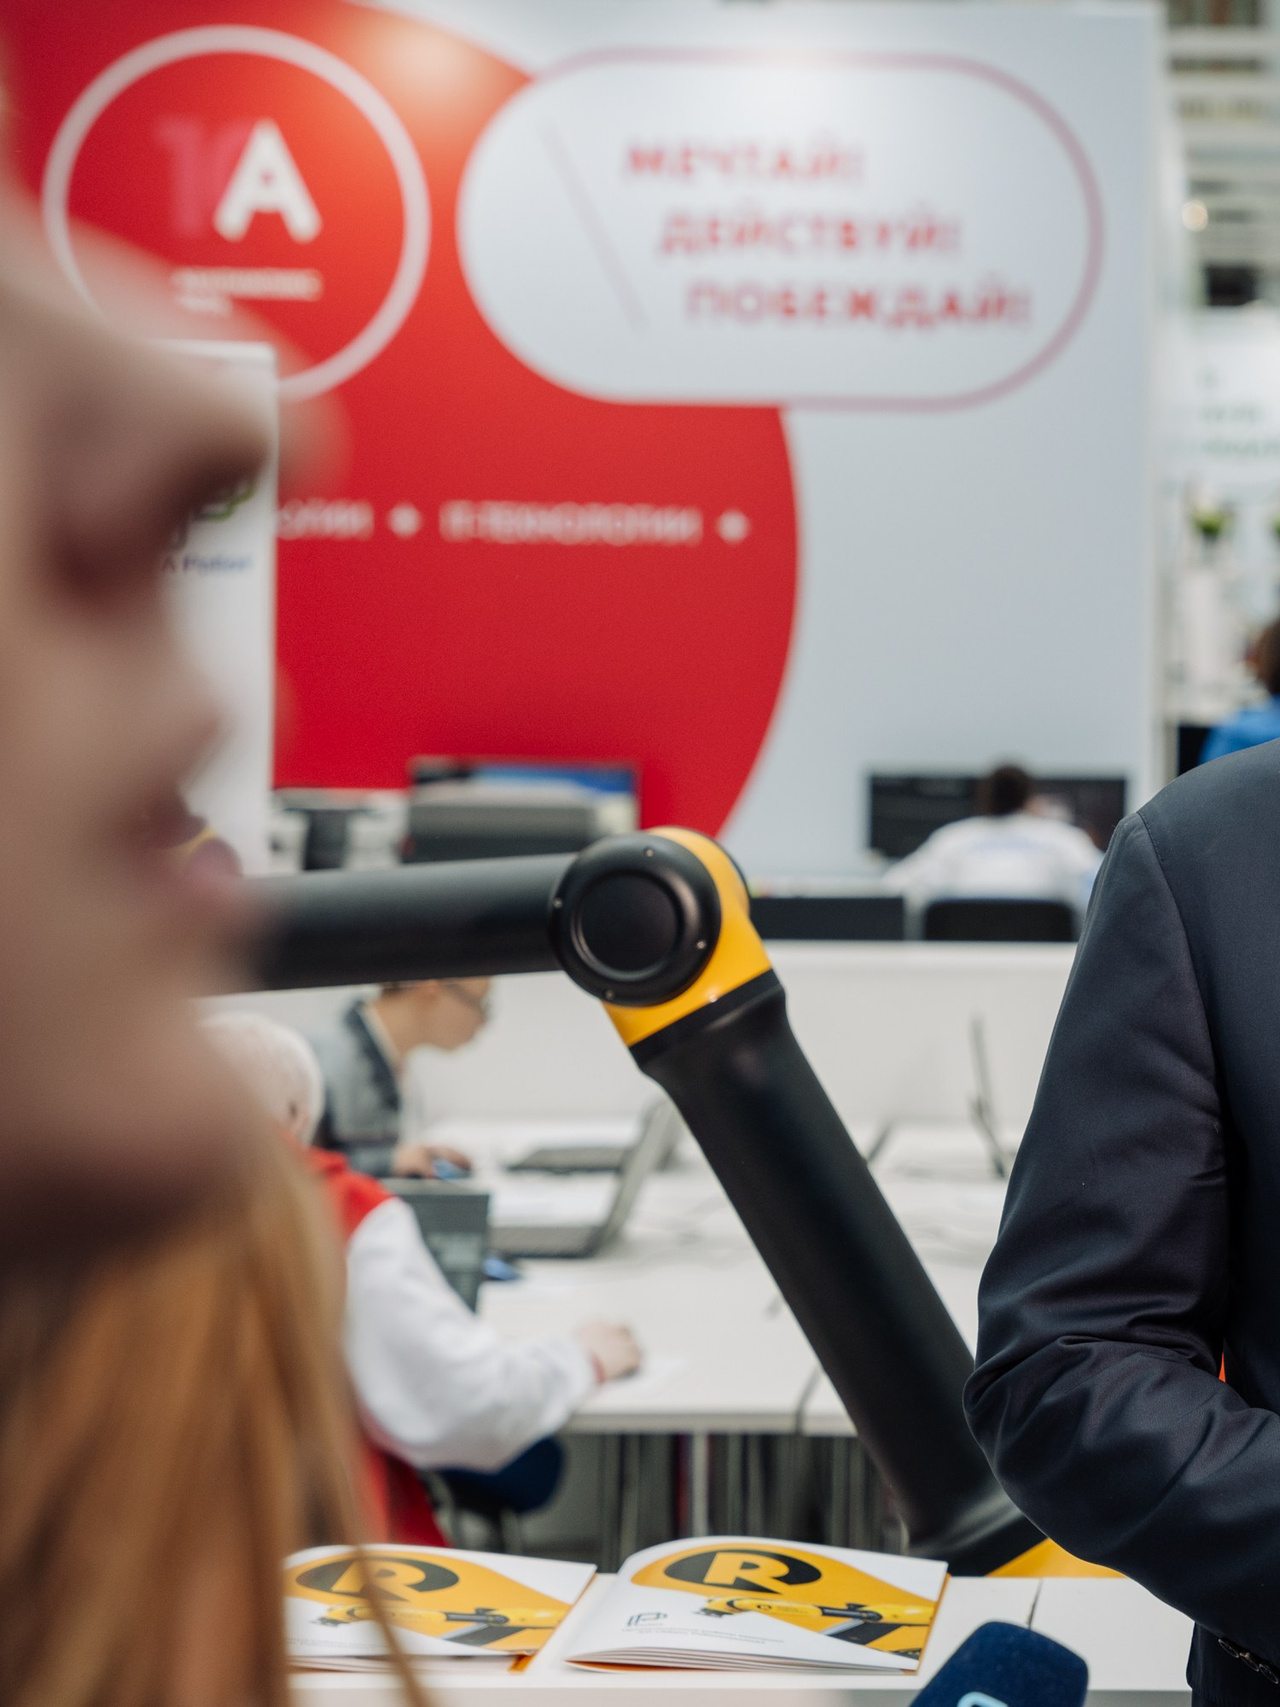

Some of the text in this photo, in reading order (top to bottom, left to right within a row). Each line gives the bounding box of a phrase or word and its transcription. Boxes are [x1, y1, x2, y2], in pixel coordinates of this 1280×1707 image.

[623, 131, 863, 182] МЕЧТАЙ!
[658, 204, 962, 257] ДЕЙСТВУЙ!
[686, 273, 1032, 329] ПОБЕЖДАЙ!
[702, 1552, 791, 1593] R
